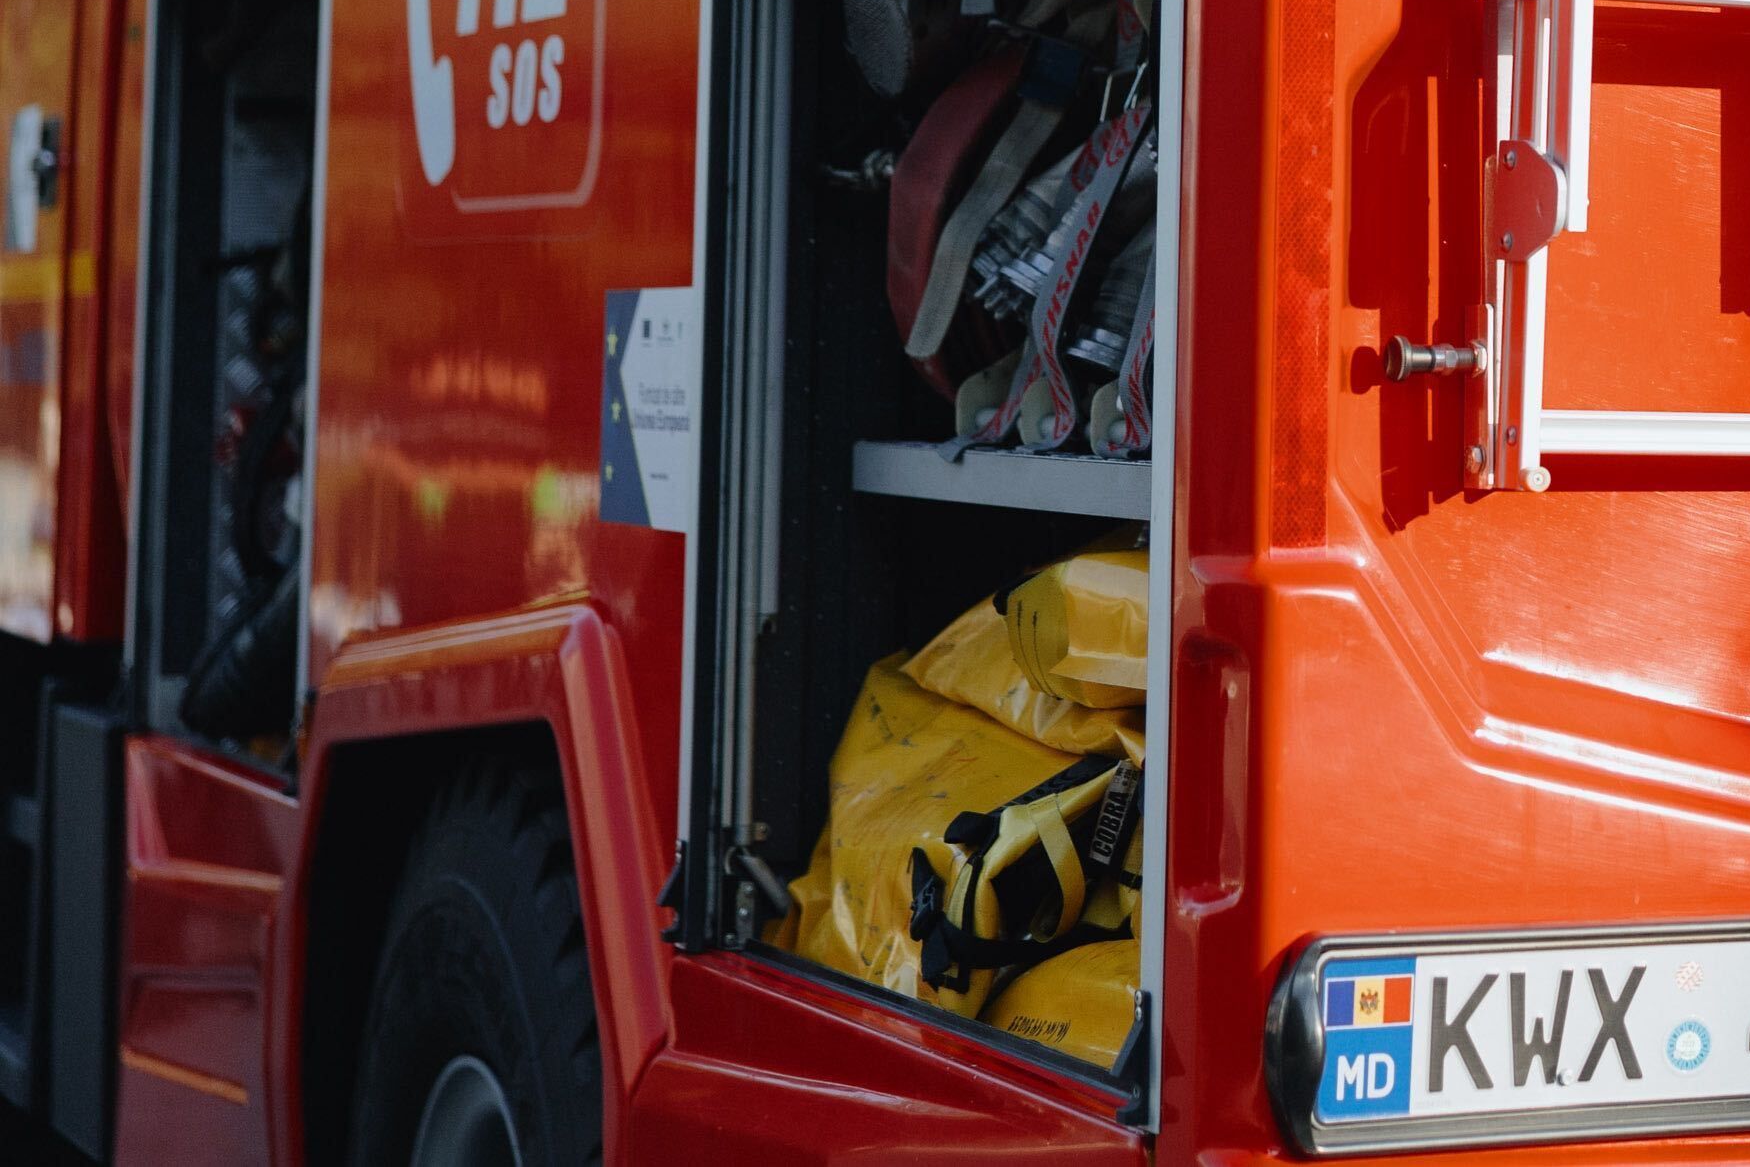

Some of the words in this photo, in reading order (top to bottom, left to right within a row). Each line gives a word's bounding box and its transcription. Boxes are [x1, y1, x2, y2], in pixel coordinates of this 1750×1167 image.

[487, 34, 565, 129] SOS
[1092, 791, 1130, 857] COBRA
[1427, 964, 1647, 1093] KWX
[1334, 1051, 1396, 1101] MD
